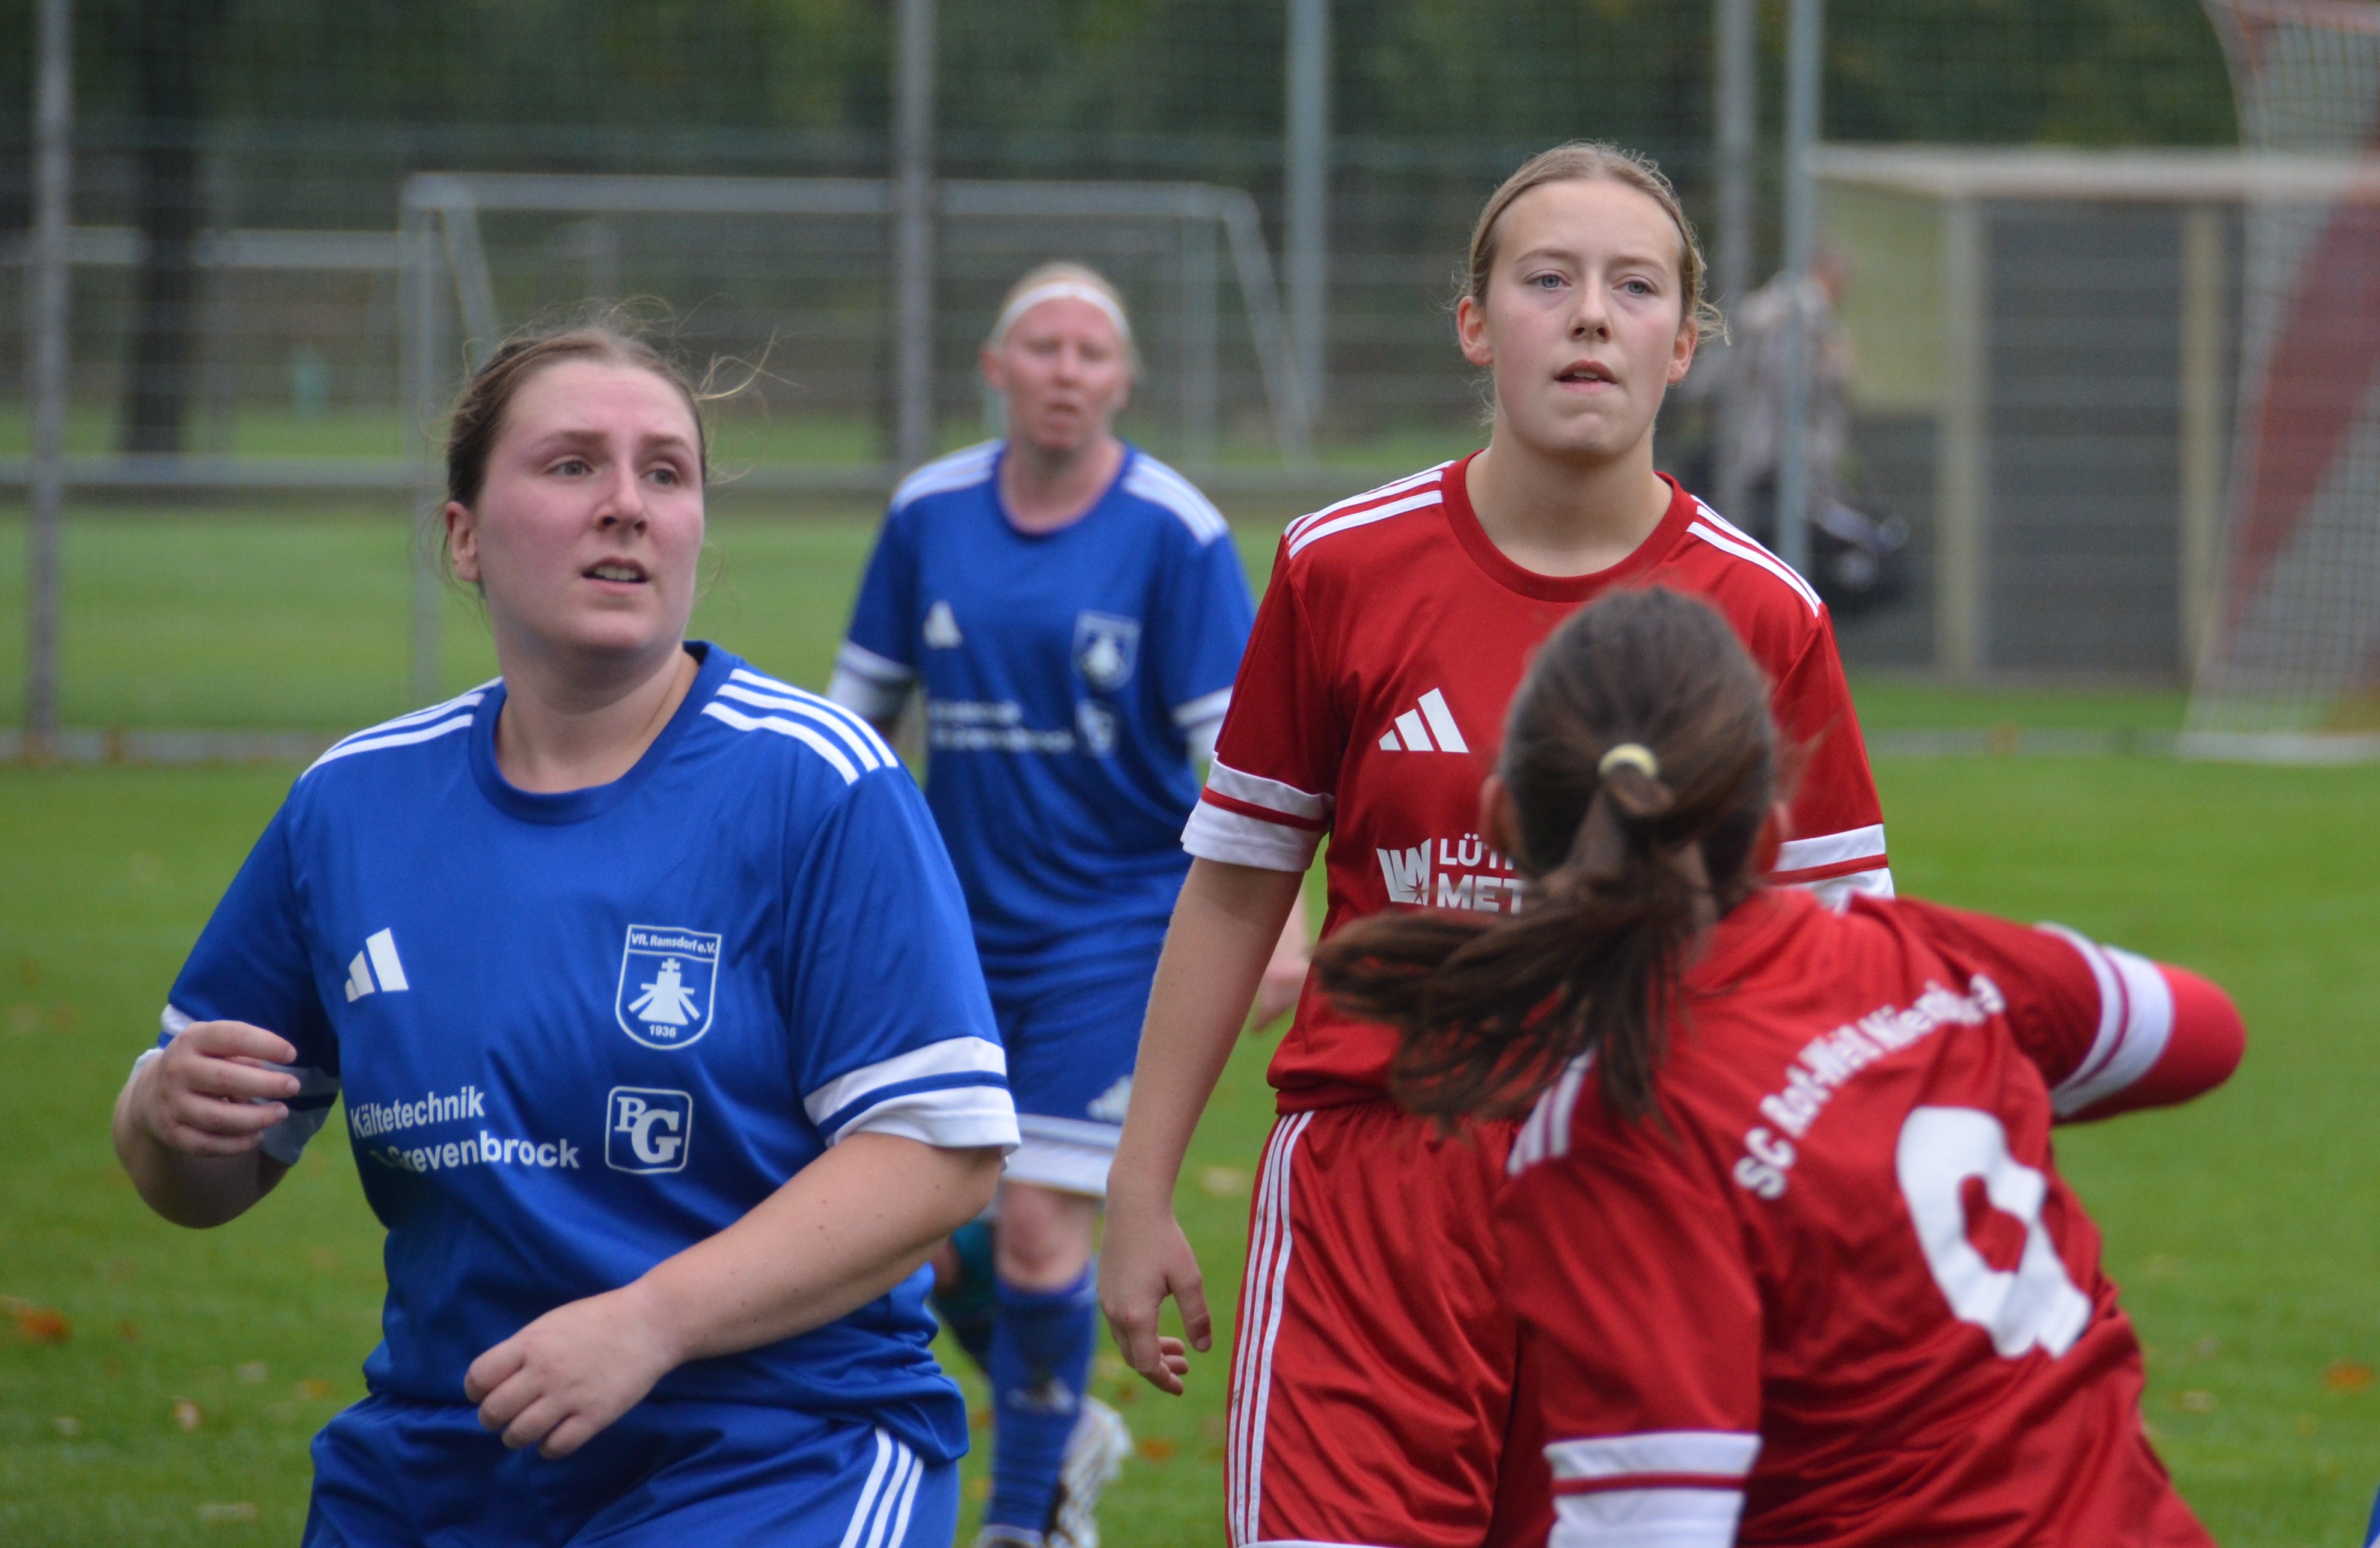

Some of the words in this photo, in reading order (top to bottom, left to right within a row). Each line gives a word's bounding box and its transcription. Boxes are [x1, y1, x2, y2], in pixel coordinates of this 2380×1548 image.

[1439, 833, 1513, 870] LÜT
[632, 933, 648, 945] VfL
[650, 935, 697, 951] Ramsdorf
[698, 942, 715, 954] e.V.
[649, 1025, 677, 1038] 1936
[350, 1086, 485, 1139] Kältetechnik
[1734, 1127, 1796, 1198] SC
